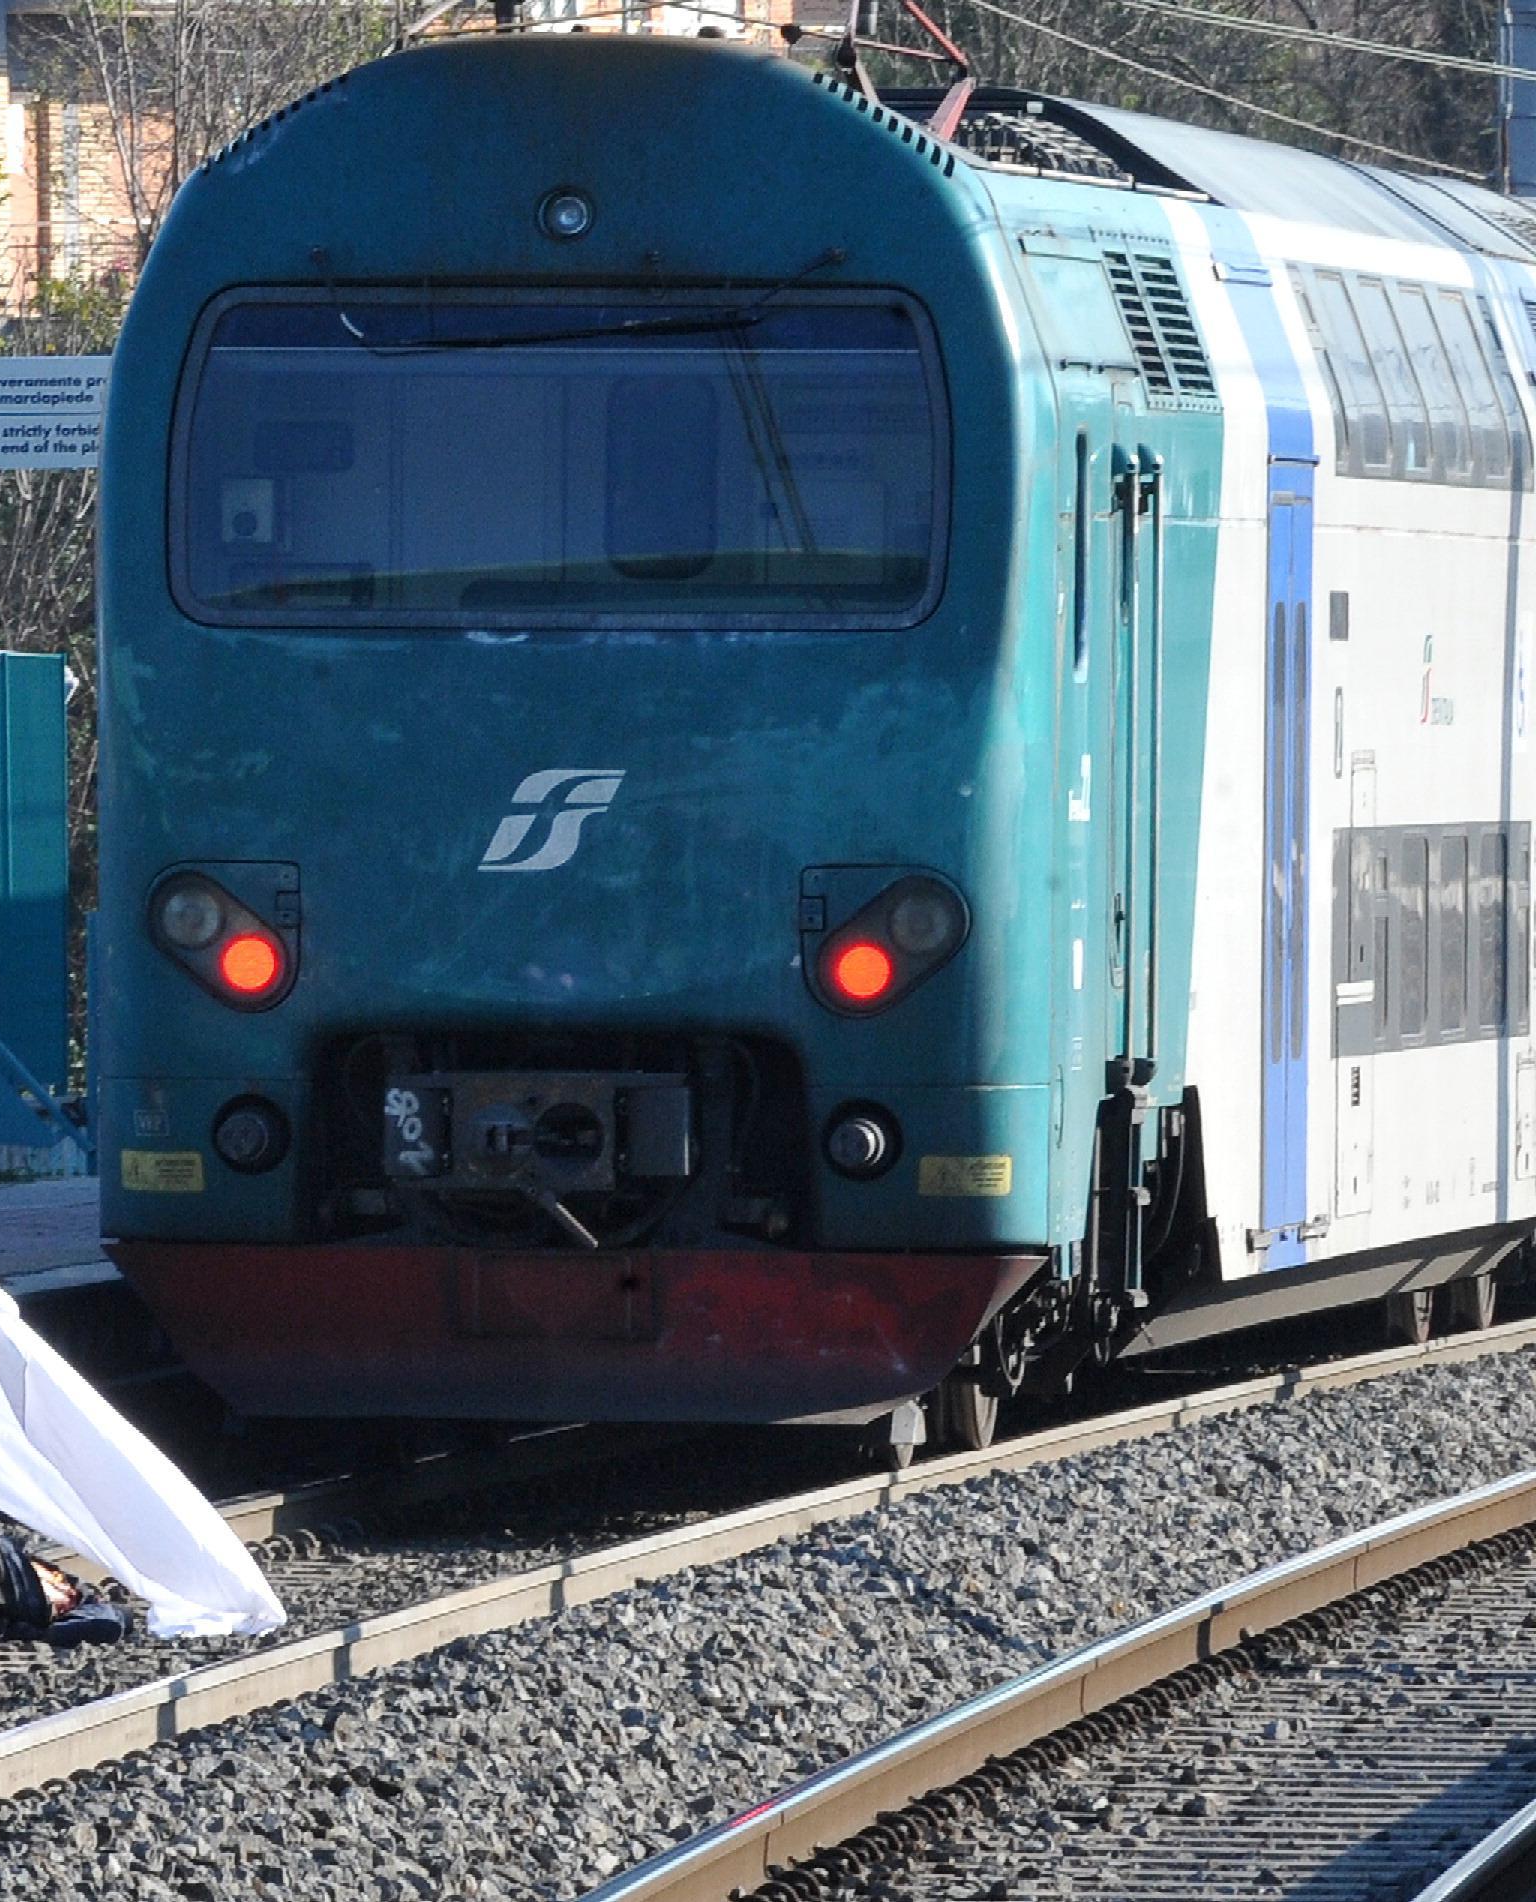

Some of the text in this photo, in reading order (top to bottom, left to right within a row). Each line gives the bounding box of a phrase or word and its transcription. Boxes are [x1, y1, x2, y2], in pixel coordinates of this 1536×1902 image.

[0, 391, 94, 407] marciapiede
[2, 424, 52, 440] strictly
[0, 441, 29, 453] end
[33, 440, 50, 453] of
[53, 440, 77, 453] the
